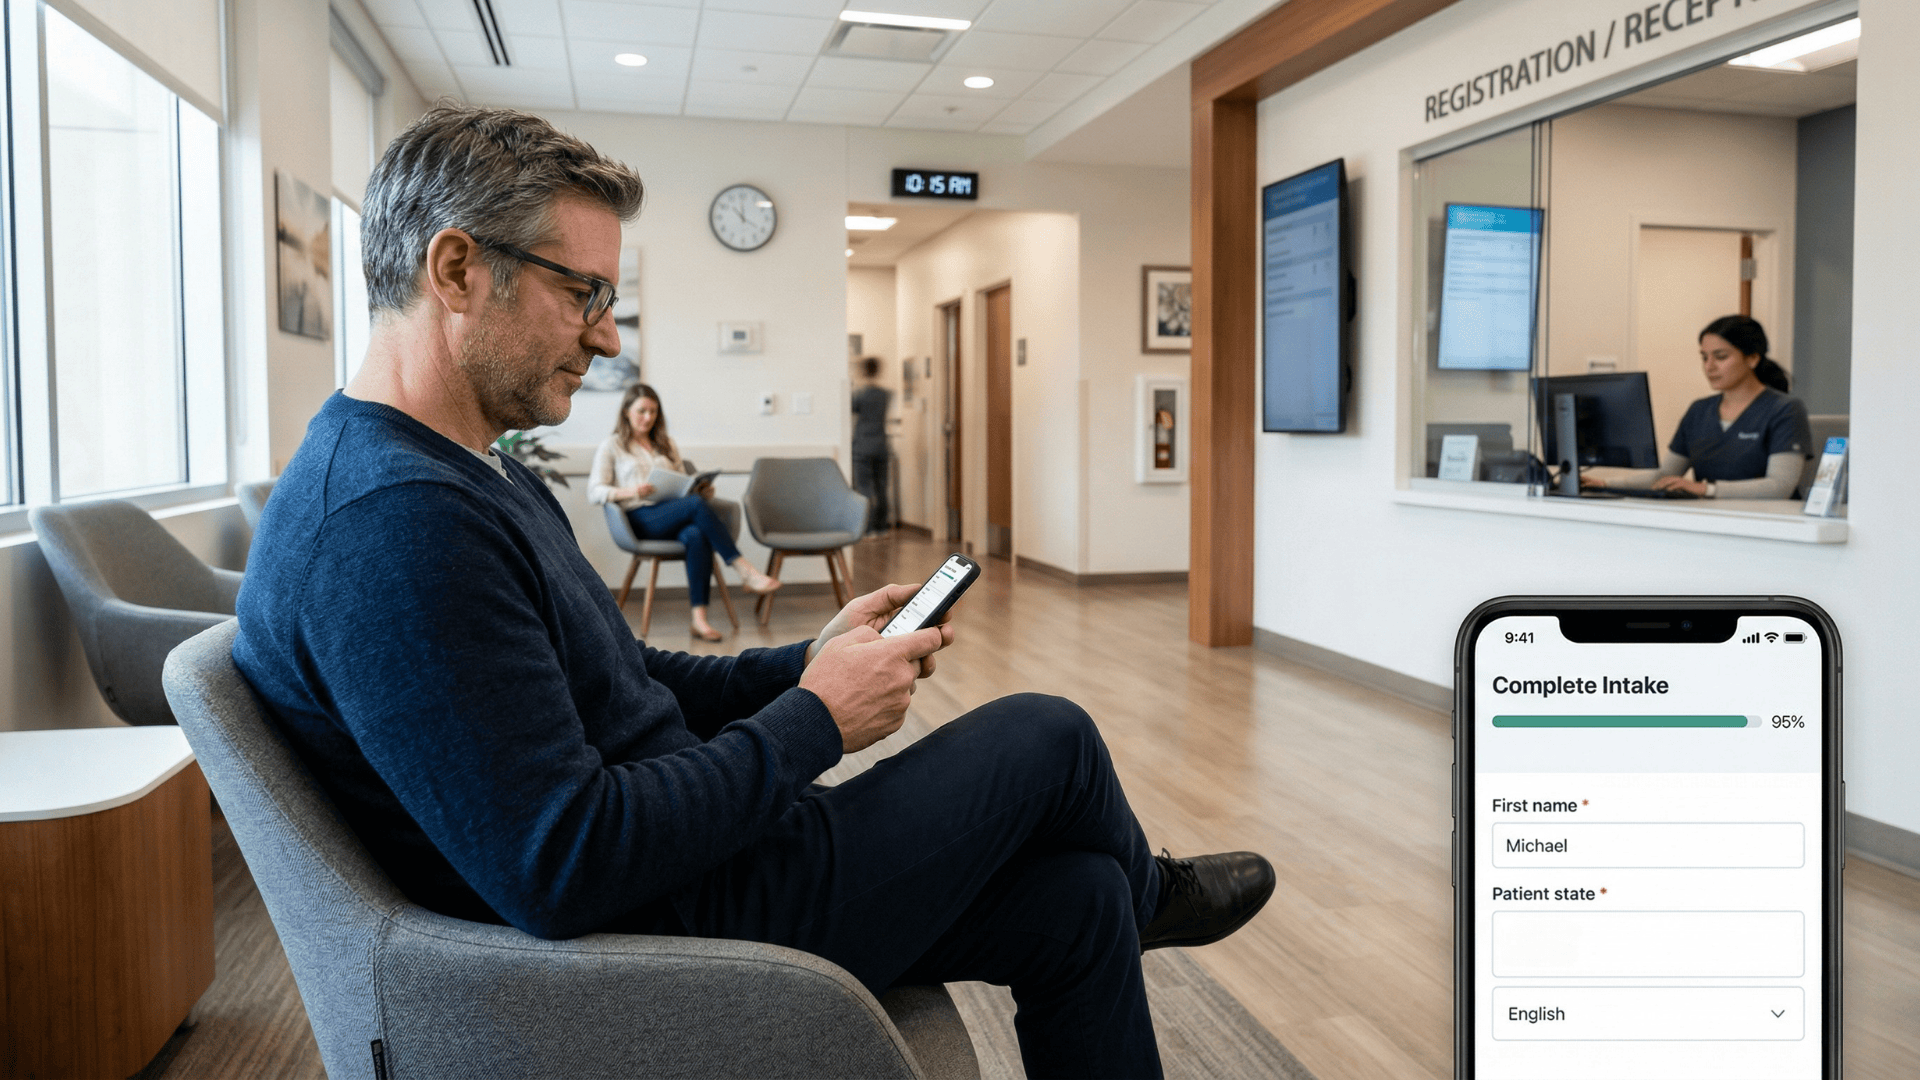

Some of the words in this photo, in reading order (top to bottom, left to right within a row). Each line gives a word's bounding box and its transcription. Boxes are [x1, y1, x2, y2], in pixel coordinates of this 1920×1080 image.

[1425, 30, 1596, 122] REGISTRATION
[1603, 20, 1616, 58] /
[1625, 0, 1757, 48] RECE
[948, 175, 972, 195] AM
[1504, 631, 1534, 645] 9:41
[1492, 676, 1597, 698] Complete
[1602, 676, 1669, 694] Intake
[1771, 714, 1805, 729] 95%
[1492, 798, 1528, 813] First
[1532, 801, 1578, 813] name
[1506, 838, 1568, 853] Michael
[1492, 886, 1550, 901] Patient
[1554, 887, 1596, 901] state
[1508, 1006, 1566, 1024] English
